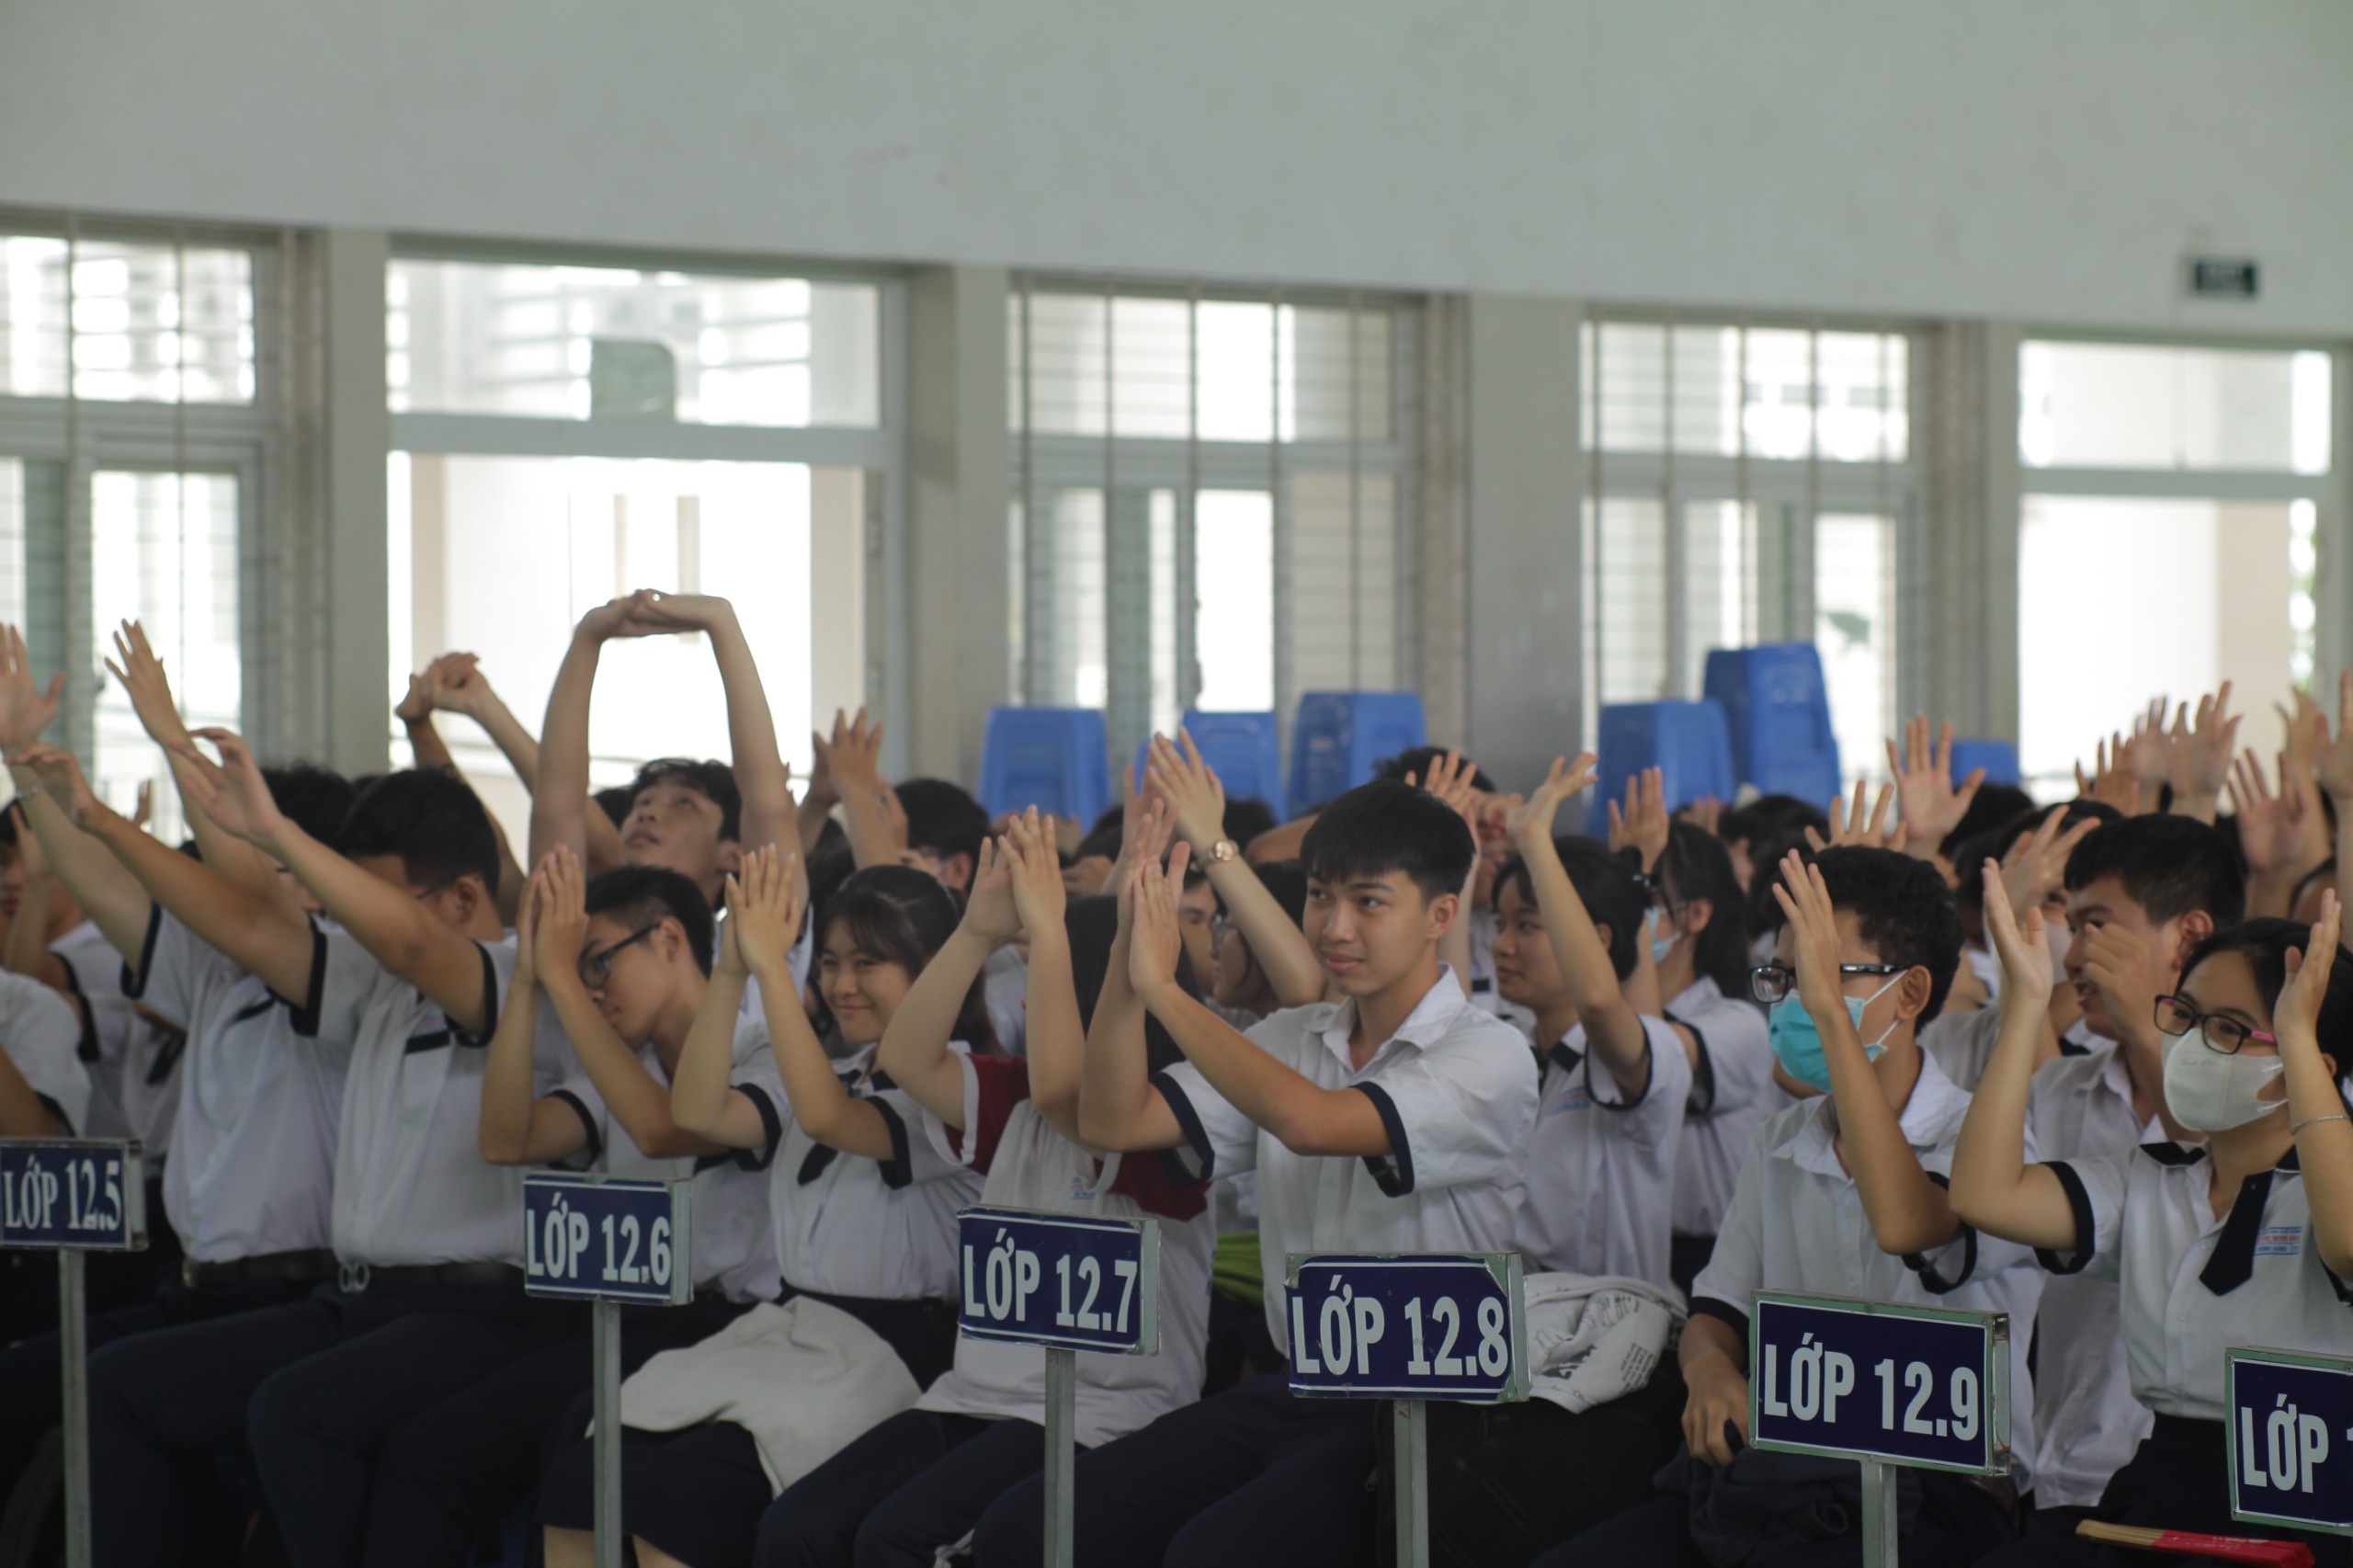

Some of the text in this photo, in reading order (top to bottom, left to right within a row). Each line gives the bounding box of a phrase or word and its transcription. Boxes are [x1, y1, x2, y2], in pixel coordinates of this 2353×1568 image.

[3, 1153, 121, 1231] LỚP 12.5
[527, 1192, 671, 1286] LỚP 12.6
[964, 1228, 1138, 1334] LỚP 12.7
[1292, 1275, 1385, 1376] LỚP
[1404, 1296, 1508, 1378] 12.8
[1764, 1332, 1979, 1441] LỚP 12.9
[2241, 1392, 2329, 1494] LỚP
